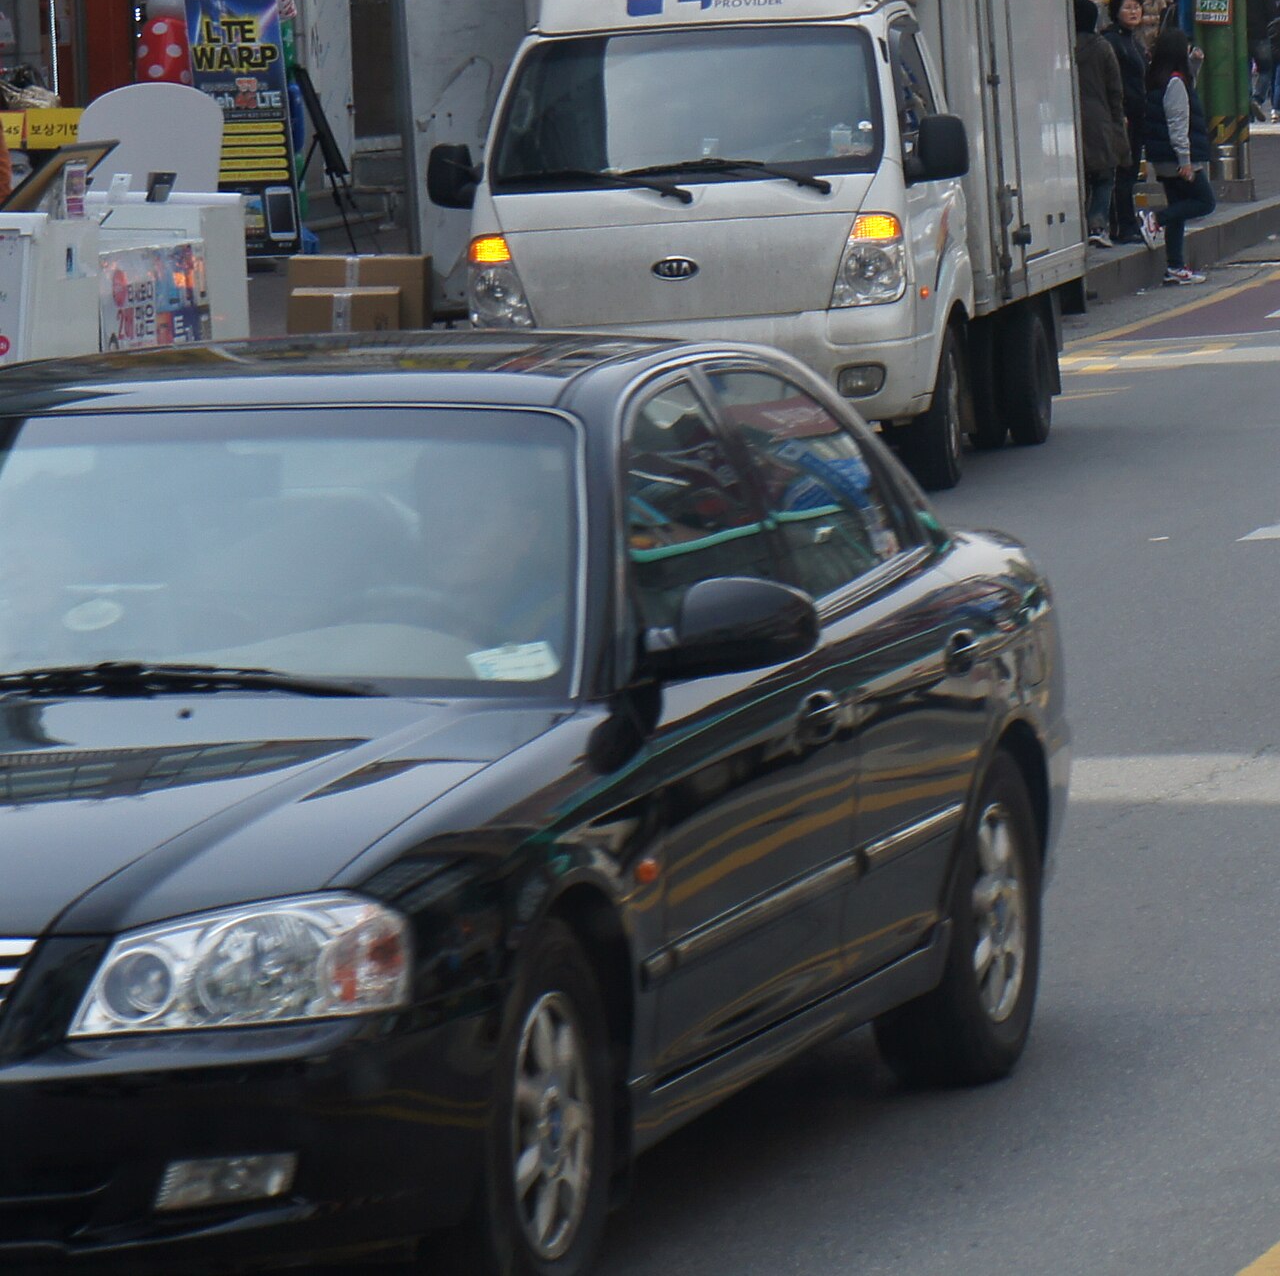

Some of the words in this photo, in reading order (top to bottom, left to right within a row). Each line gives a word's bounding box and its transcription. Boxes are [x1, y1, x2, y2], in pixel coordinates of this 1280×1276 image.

[204, 20, 256, 44] LTE
[193, 45, 279, 70] WARP
[656, 259, 694, 276] KIA
